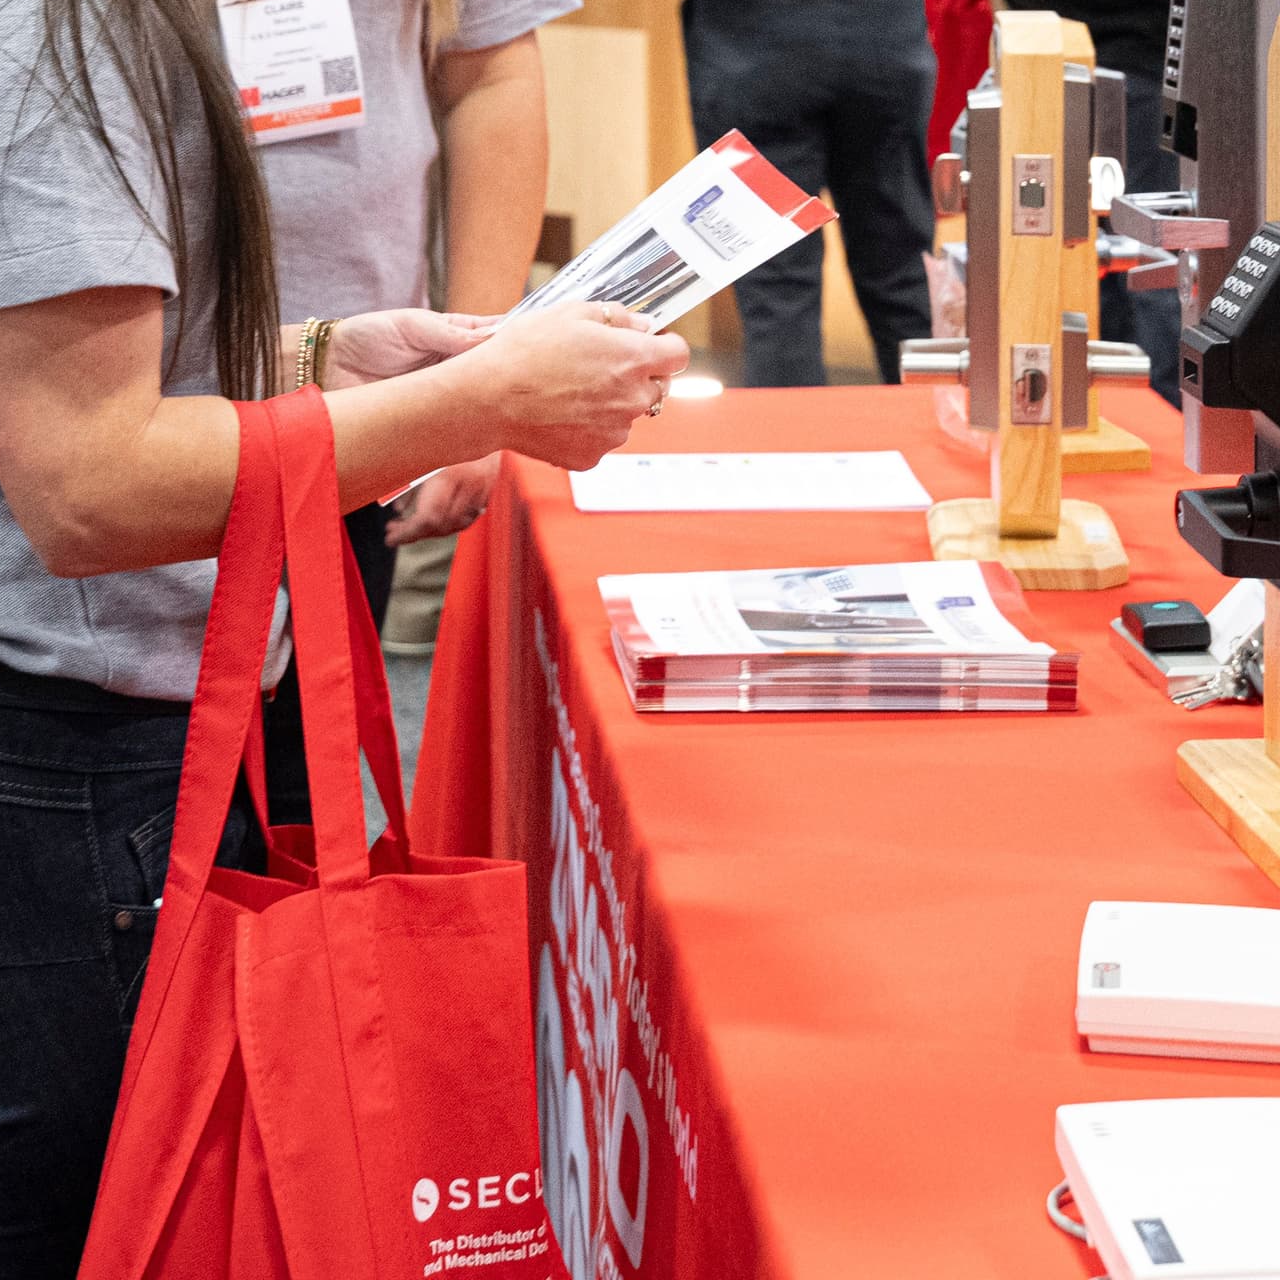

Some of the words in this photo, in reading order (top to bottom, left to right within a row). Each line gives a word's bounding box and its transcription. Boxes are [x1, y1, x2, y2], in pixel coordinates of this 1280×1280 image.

[429, 1237, 455, 1256] The
[456, 1228, 535, 1250] Distributor
[444, 1245, 527, 1270] Mechanical
